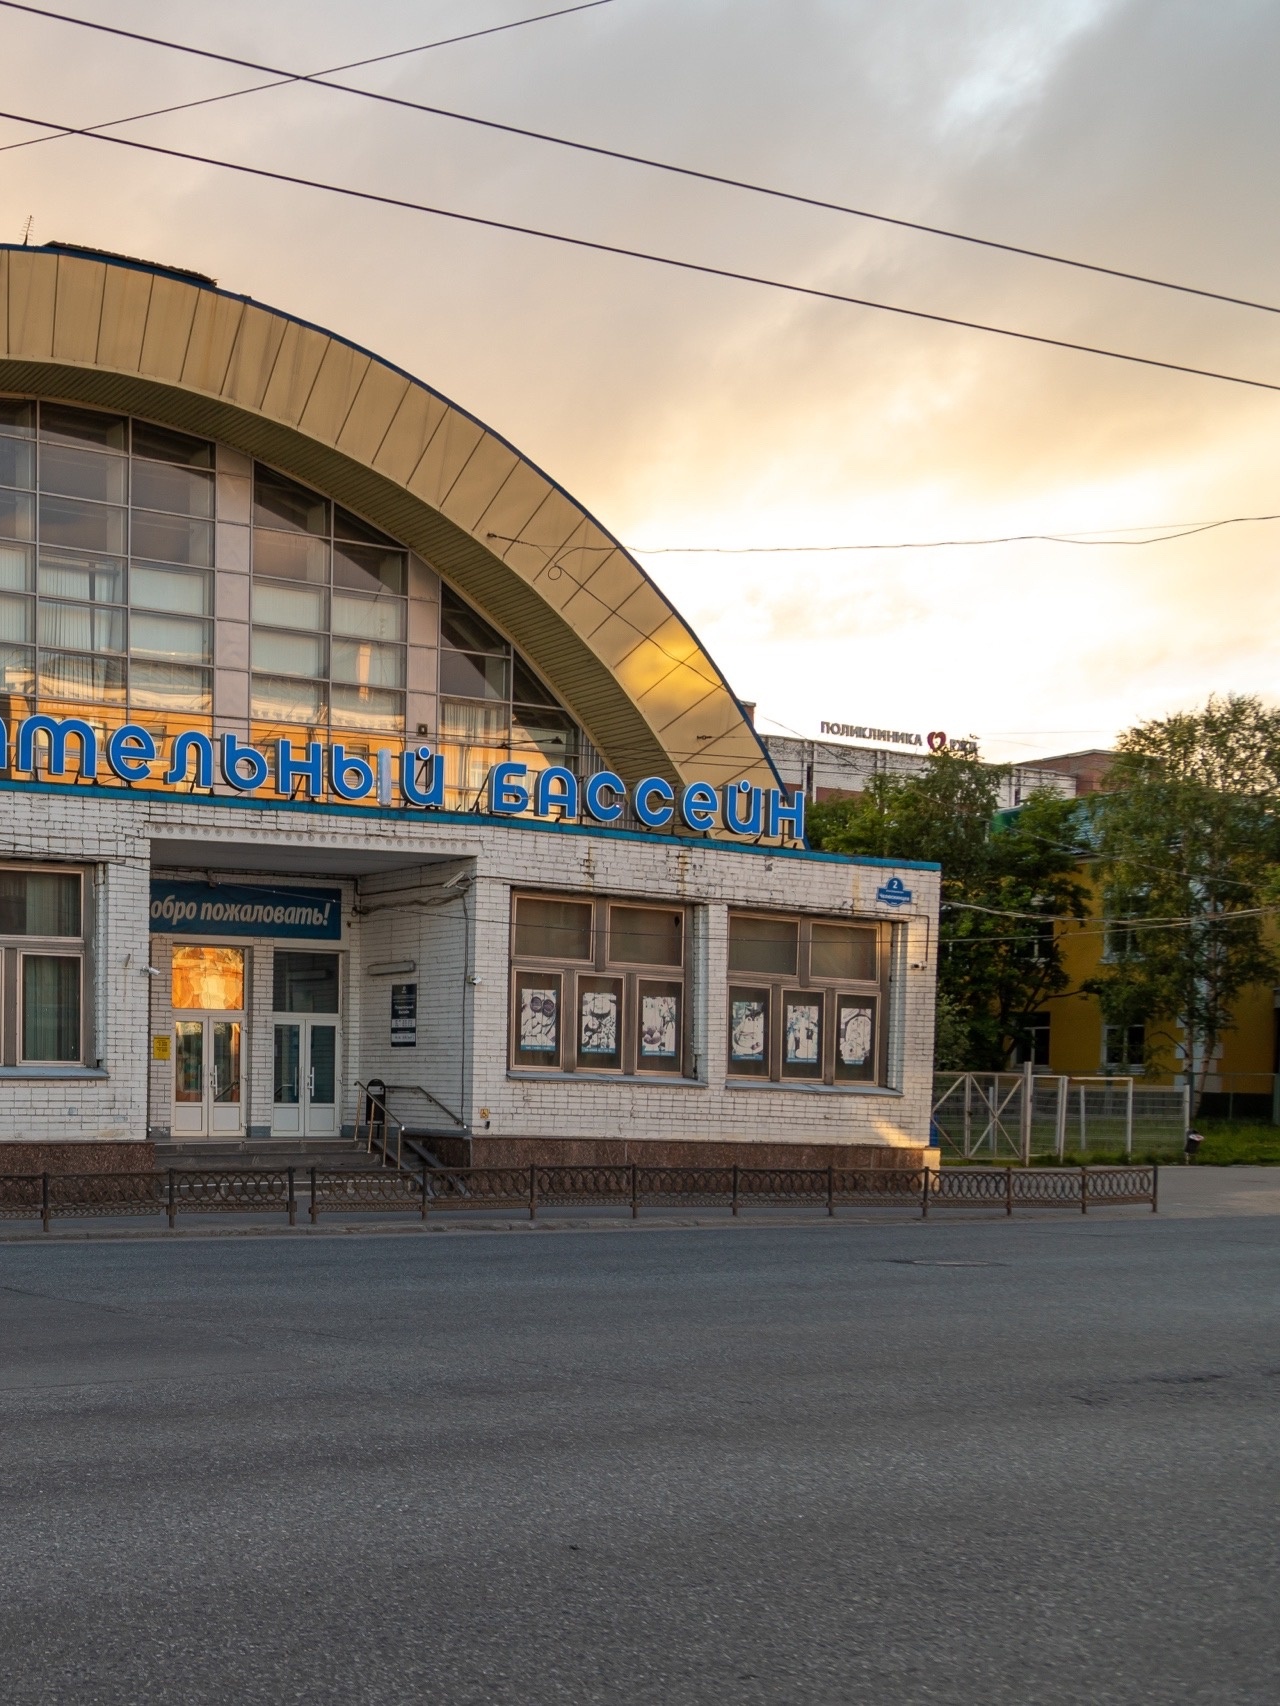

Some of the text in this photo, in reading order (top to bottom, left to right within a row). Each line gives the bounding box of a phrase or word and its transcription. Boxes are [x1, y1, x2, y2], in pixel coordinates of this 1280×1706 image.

[820, 721, 923, 747] ПОЛИКЛИНИКА
[892, 880, 899, 889] 2
[150, 894, 331, 926] обро пожаловать!
